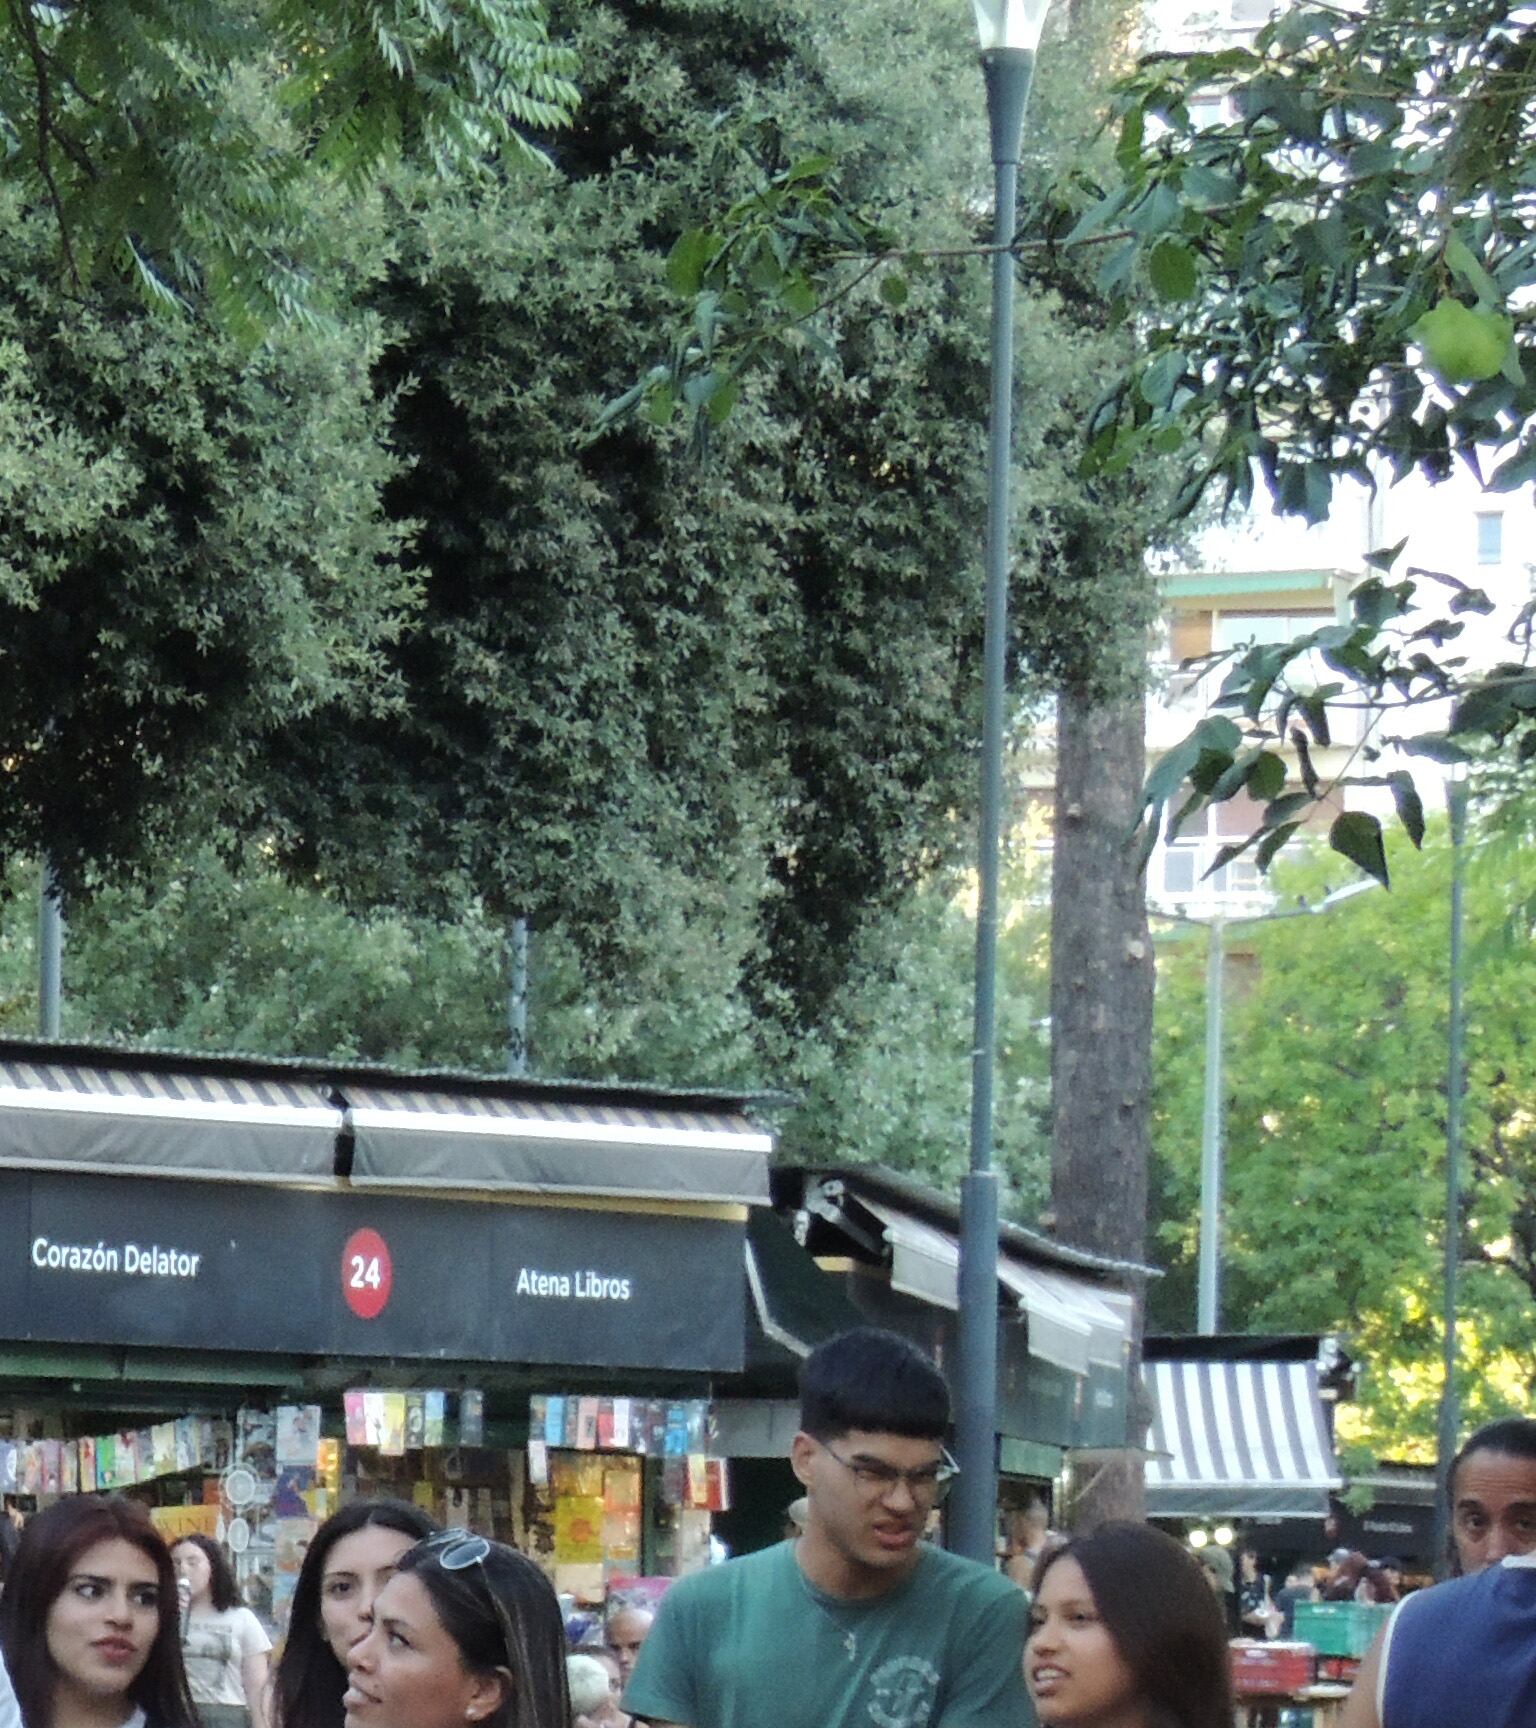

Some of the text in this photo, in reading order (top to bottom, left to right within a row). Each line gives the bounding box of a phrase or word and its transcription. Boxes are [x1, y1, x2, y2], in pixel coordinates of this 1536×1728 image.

[32, 1238, 201, 1277] Corazón Delator
[350, 1256, 381, 1289] 24
[517, 1268, 631, 1300] Atena Libros
